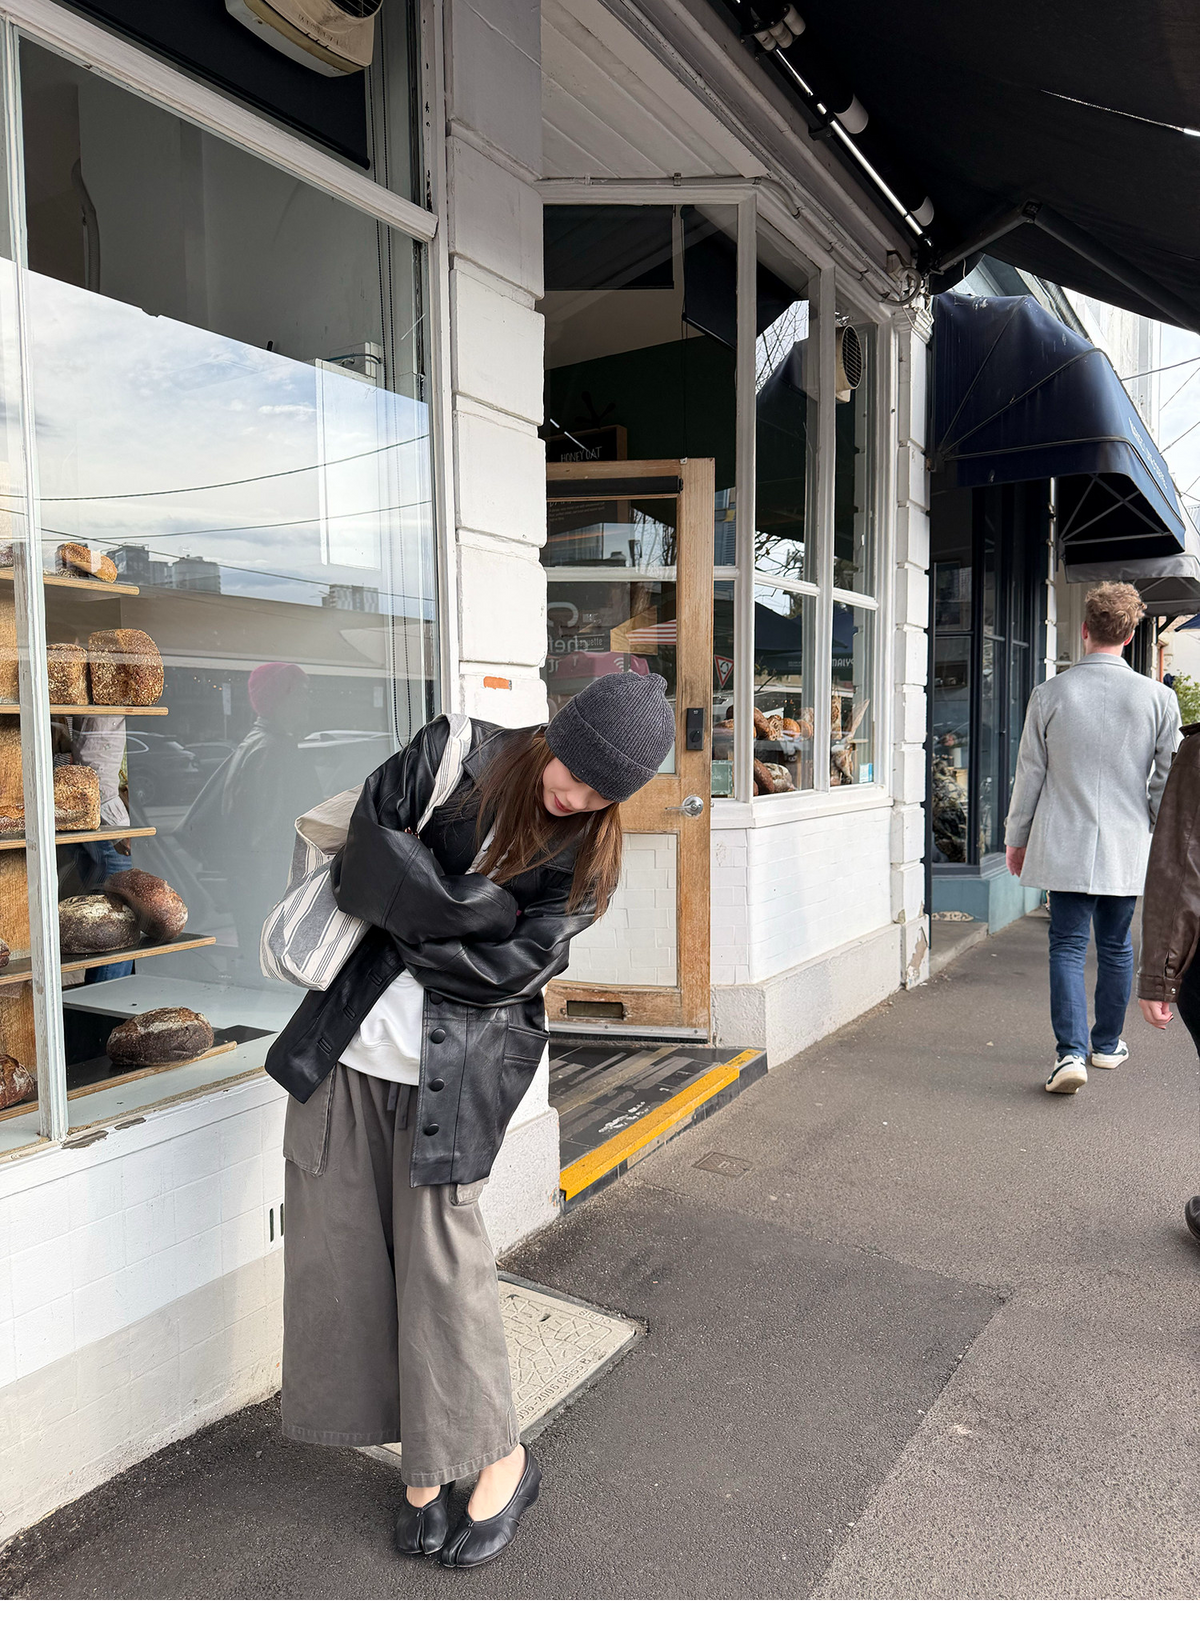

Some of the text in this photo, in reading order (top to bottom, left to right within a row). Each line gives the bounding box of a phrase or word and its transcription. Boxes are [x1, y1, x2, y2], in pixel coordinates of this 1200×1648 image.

[560, 445, 603, 462] HONEY OAT
[517, 1383, 560, 1421] 996-2006
